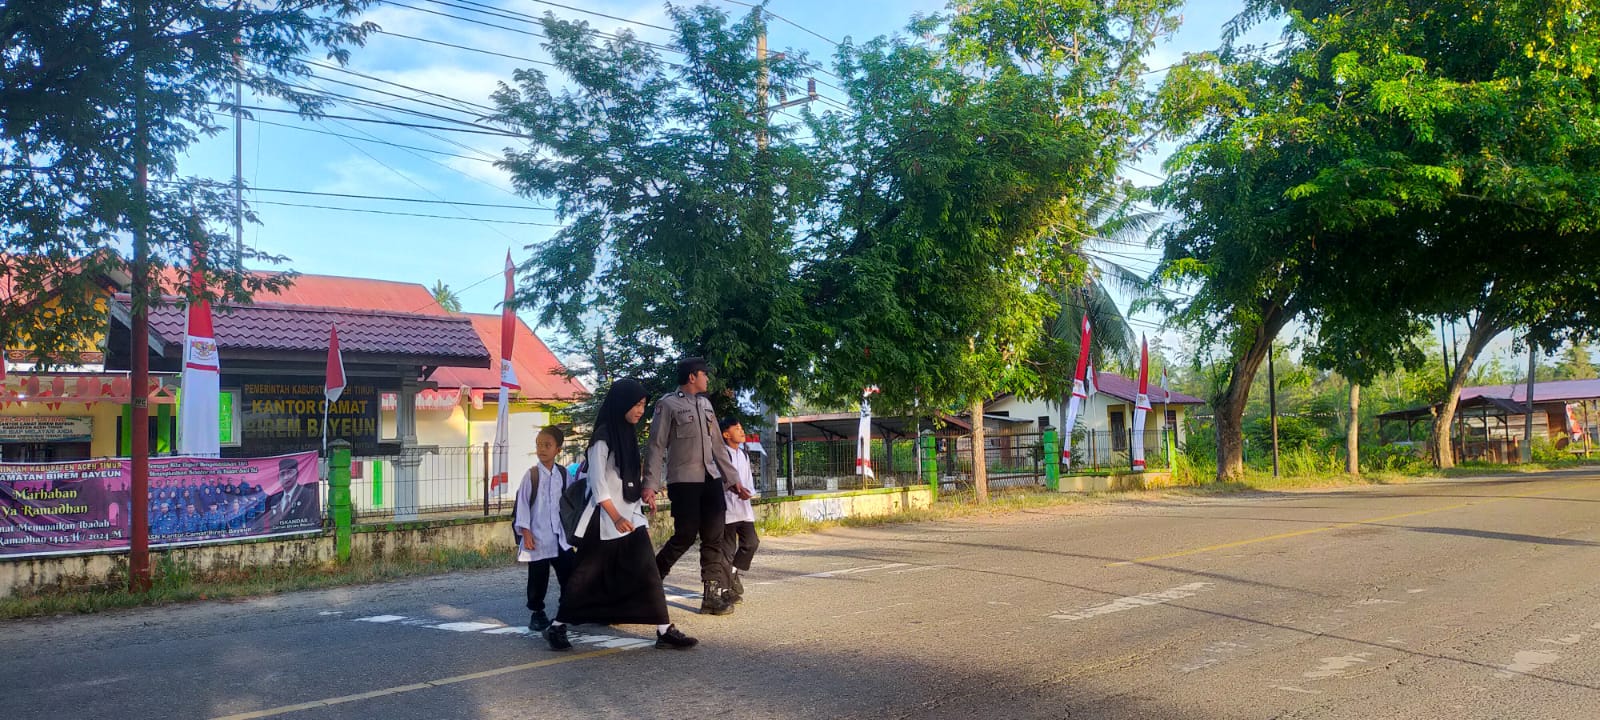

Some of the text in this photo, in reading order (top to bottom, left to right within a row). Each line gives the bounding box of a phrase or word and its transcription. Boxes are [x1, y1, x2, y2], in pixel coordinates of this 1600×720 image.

[245, 384, 290, 395] PEMERINTAH
[293, 384, 324, 395] KABUPAT
[355, 384, 375, 395] TIMUR
[252, 400, 369, 414] KANTOR CAMAT
[245, 418, 375, 438] BIREM BAYEUN
[30, 464, 75, 472] KABUPATEN
[46, 472, 79, 480] BIREM
[81, 470, 122, 478] BAYEUN
[13, 488, 77, 500] Marhaban
[2, 503, 88, 518] Ya Ramadhan
[17, 521, 76, 532] Menunaikan
[77, 519, 110, 529] Ibadah
[279, 518, 308, 526] ISKANDAR
[49, 534, 70, 544] 1445
[71, 531, 80, 542] H
[88, 531, 109, 542] 2024
[110, 529, 123, 539] M
[228, 527, 252, 535] Bayeun
